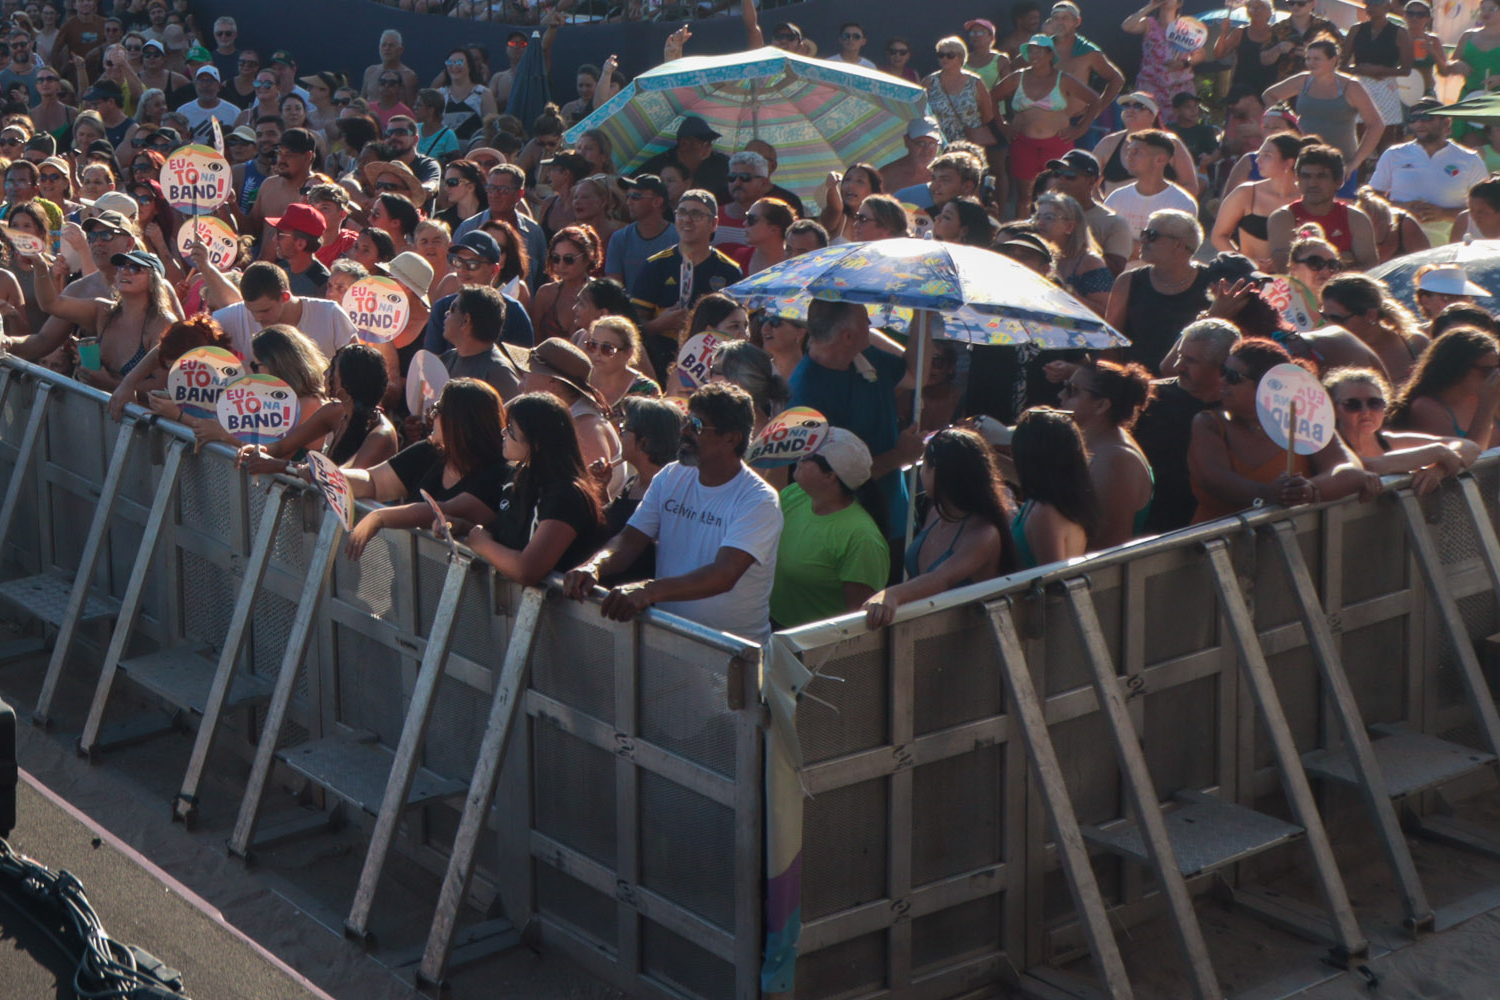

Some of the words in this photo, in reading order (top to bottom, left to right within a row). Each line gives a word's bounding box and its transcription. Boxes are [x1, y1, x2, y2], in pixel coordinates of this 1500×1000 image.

[169, 159, 186, 170] EU
[174, 162, 199, 185] TÔ
[201, 173, 216, 182] NA
[169, 178, 224, 200] BAND!
[213, 242, 226, 253] NA
[351, 286, 367, 296] EU
[1274, 278, 1291, 292] EU
[355, 291, 378, 312] TÔ
[379, 303, 393, 312] NA
[349, 310, 401, 329] BAND!
[180, 360, 197, 370] EU
[184, 364, 211, 387] TÔ
[211, 376, 228, 386] NA
[226, 388, 245, 400] EU
[232, 391, 261, 415] TÔ
[263, 401, 280, 409] NA
[228, 406, 290, 430] BAND!
[760, 423, 779, 437] EU
[763, 422, 788, 445] TÔ
[788, 429, 807, 437] NA
[751, 434, 818, 460] BAND!
[664, 499, 698, 520] Calvin
